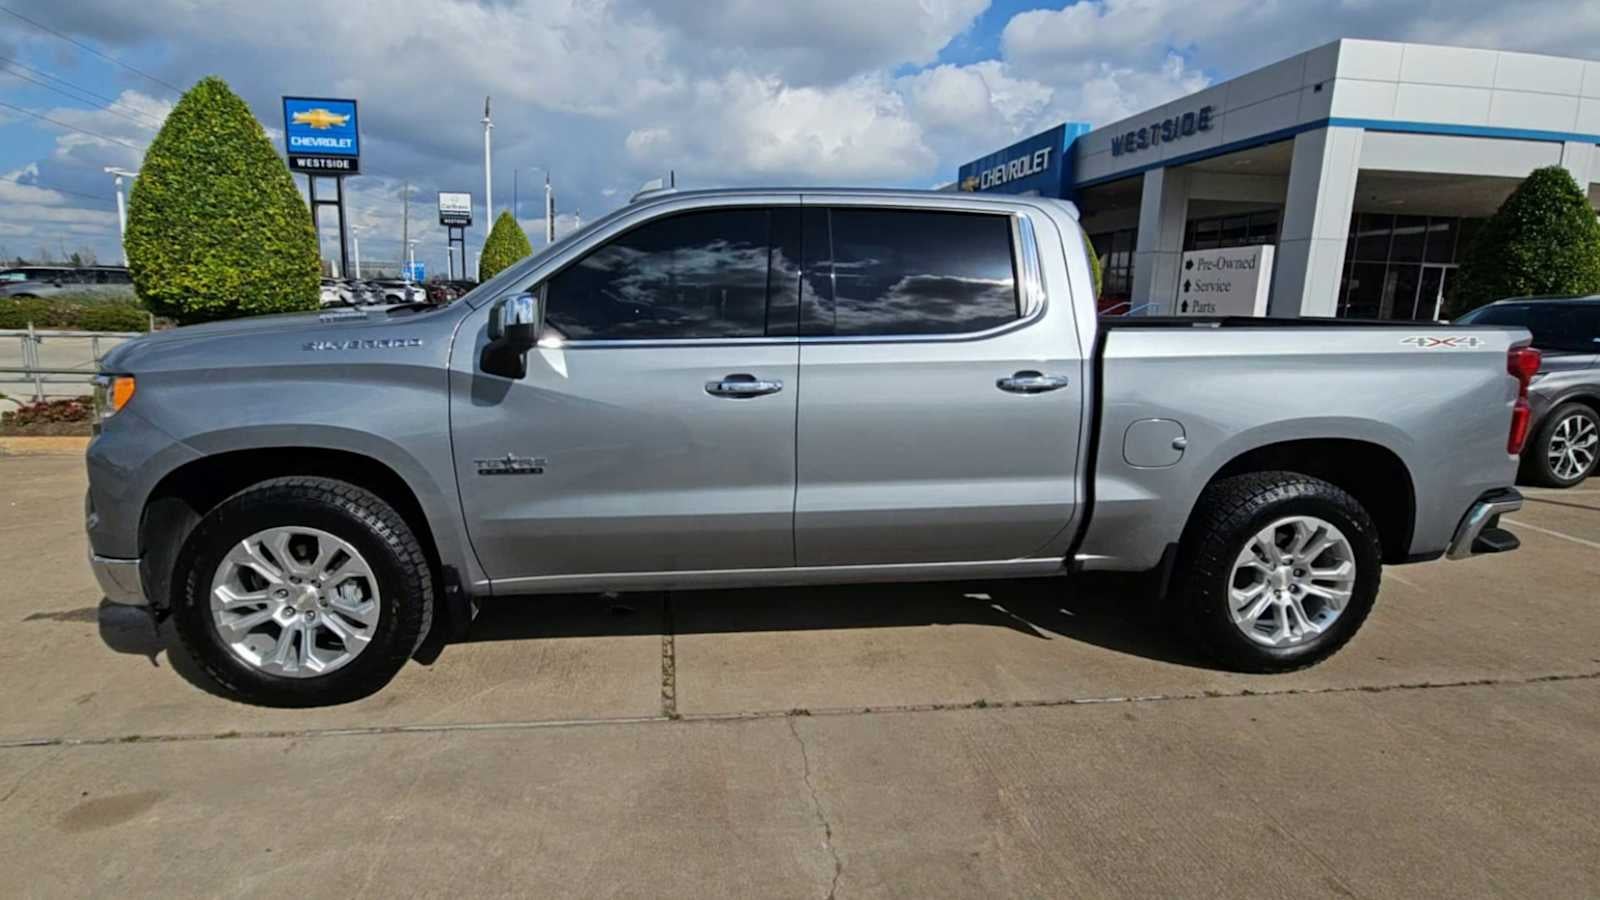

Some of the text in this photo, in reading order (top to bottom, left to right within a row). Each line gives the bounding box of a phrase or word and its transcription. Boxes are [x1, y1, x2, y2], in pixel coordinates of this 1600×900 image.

[1111, 105, 1215, 157] WESTSIDE
[290, 136, 352, 148] CHEVROLET
[296, 158, 350, 169] WESTSIDE
[980, 147, 1052, 190] CHEVROLET
[1197, 254, 1257, 271] Pre-Owned
[1194, 279, 1231, 293] Service
[1192, 299, 1216, 313] Parts
[301, 338, 422, 351] SILVERADO
